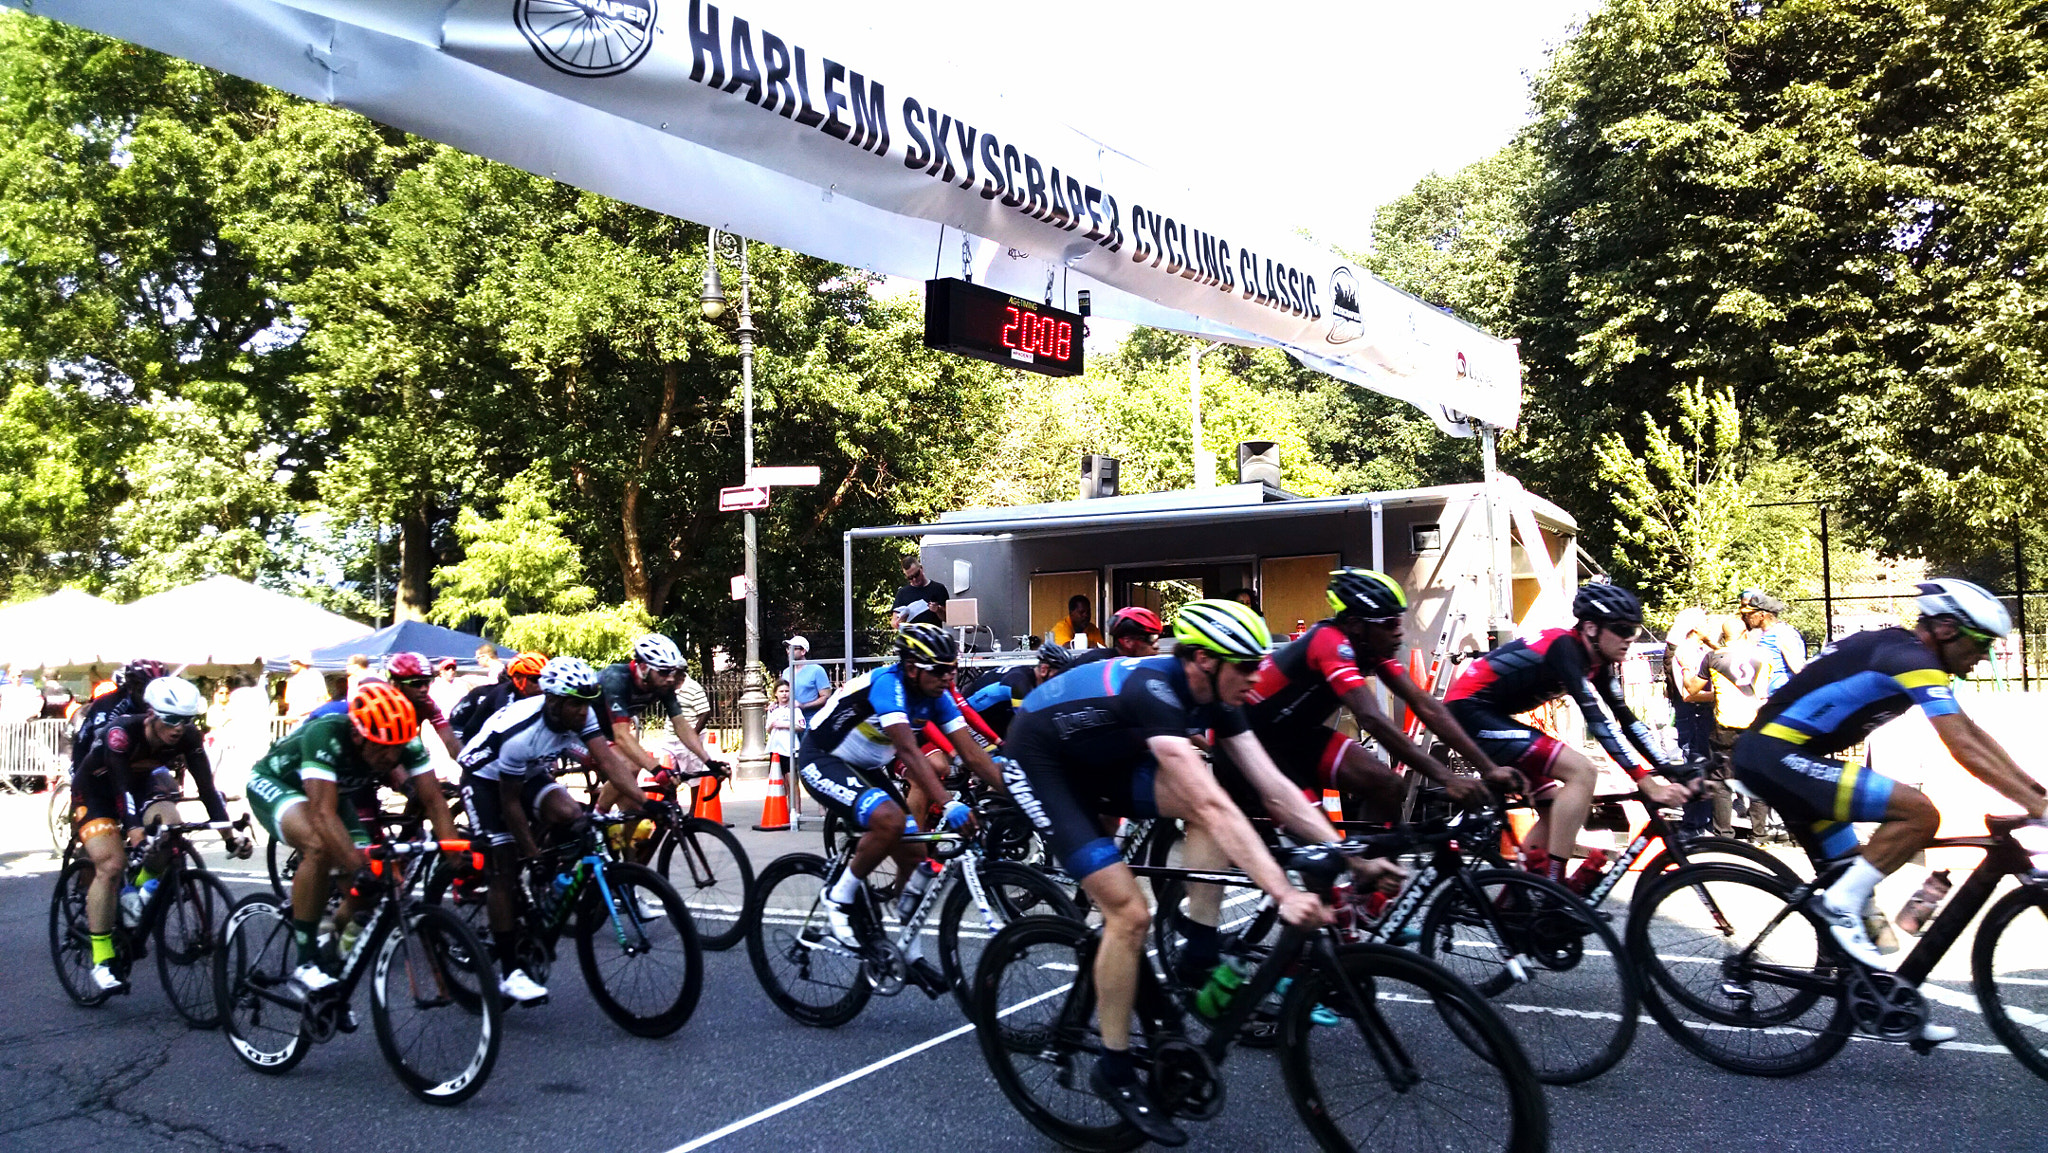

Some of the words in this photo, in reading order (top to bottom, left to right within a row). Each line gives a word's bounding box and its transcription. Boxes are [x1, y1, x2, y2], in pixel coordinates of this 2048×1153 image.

[579, 0, 649, 25] RAPER
[689, 0, 890, 157] HARLEM
[903, 97, 1124, 252] SKYSCRAPER
[1132, 204, 1235, 293] CYCLING
[1239, 250, 1321, 322] CLASSIC
[1003, 306, 1071, 360] 20:08
[801, 763, 858, 802] BRANDS
